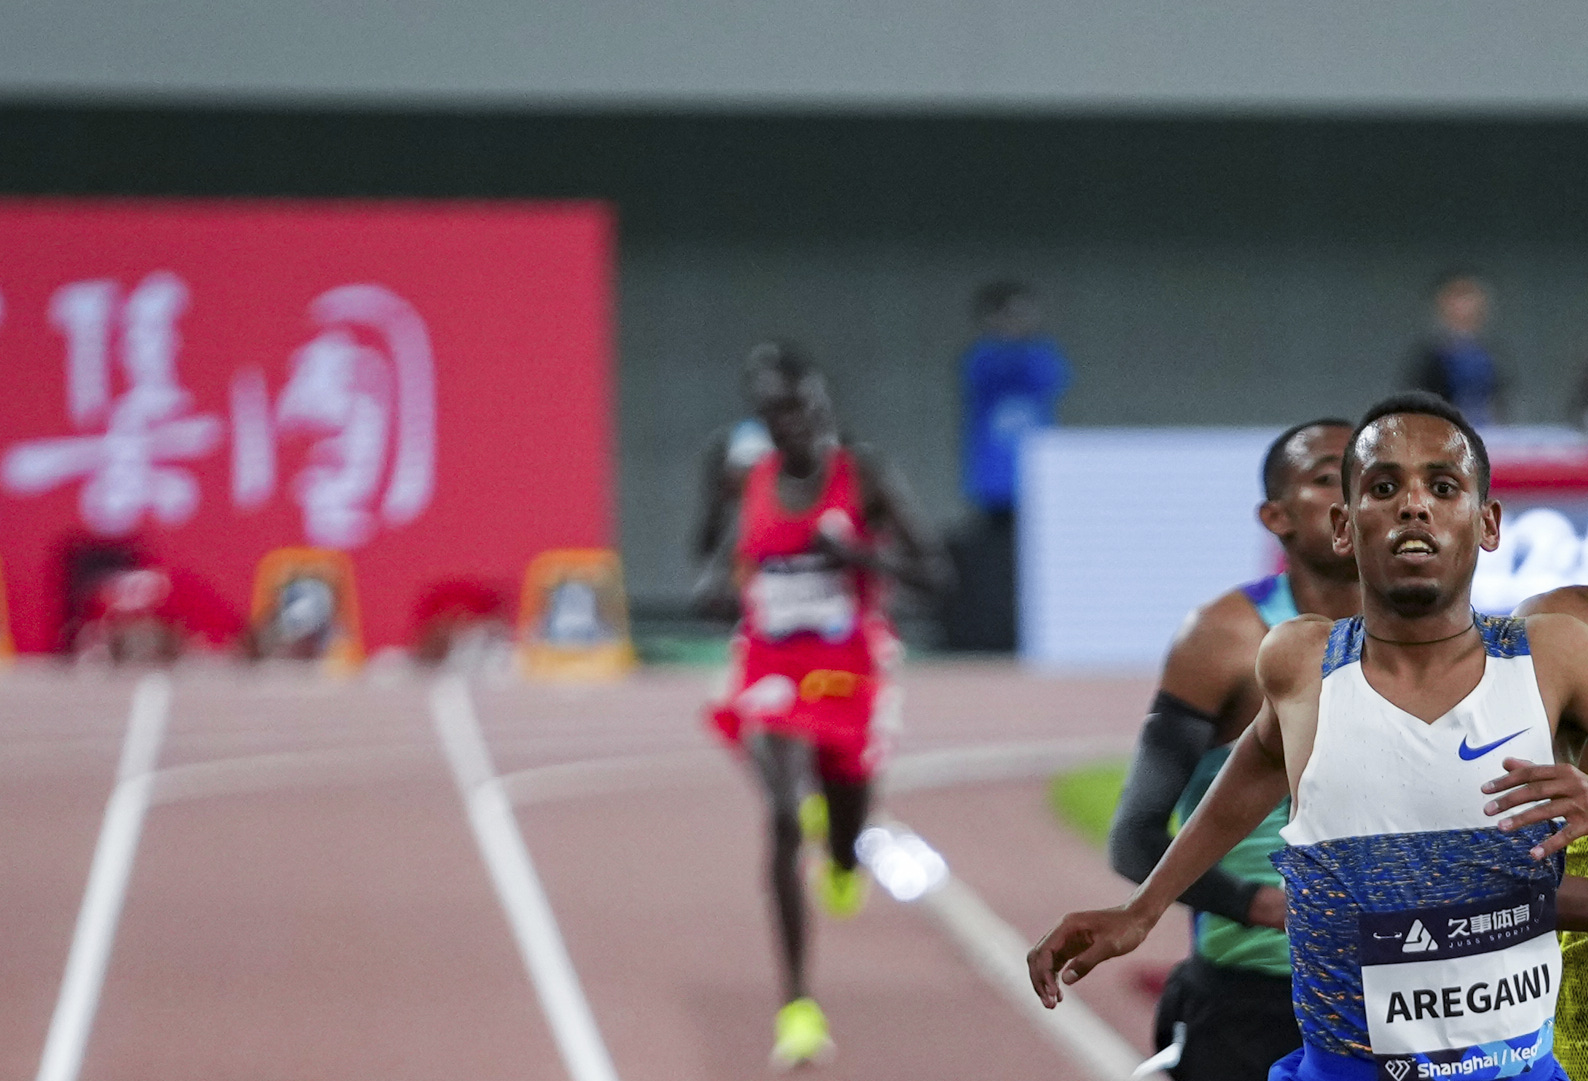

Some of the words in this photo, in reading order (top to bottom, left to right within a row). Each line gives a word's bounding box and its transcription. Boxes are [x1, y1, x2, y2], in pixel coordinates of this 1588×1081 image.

[1447, 903, 1531, 938] 久事体育
[1449, 938, 1481, 948] JUSS
[1489, 925, 1531, 942] SPORTS
[1386, 963, 1551, 1024] AREGAWI
[1417, 1052, 1498, 1079] Shanghai
